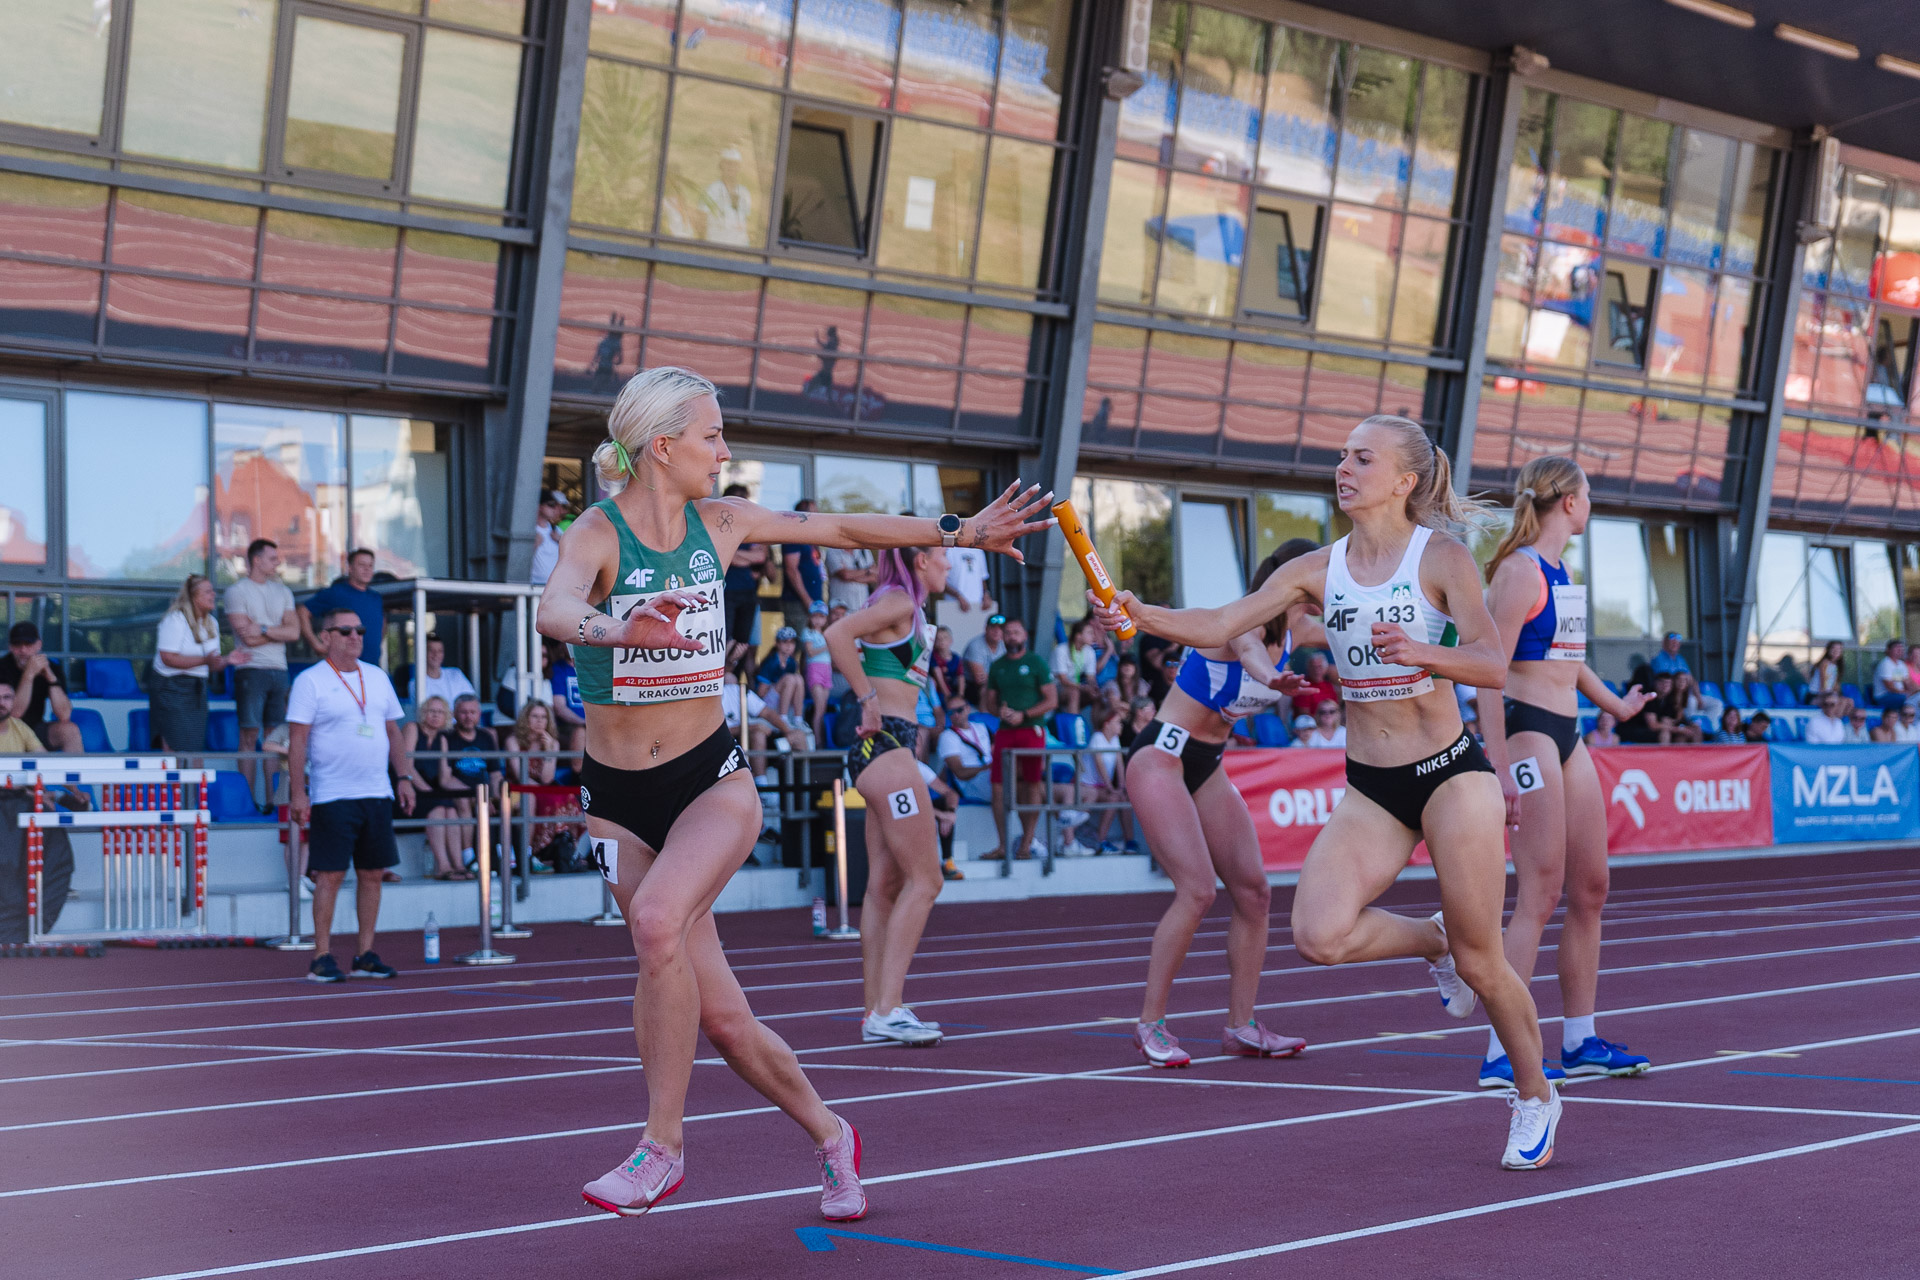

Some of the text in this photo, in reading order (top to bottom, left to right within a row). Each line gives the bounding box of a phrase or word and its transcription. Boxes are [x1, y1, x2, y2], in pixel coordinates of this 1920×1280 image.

[694, 554, 710, 567] AZS
[624, 568, 655, 588] 4F
[697, 569, 714, 582] AWF
[1326, 607, 1359, 632] 4F
[1375, 605, 1415, 623] 133
[656, 676, 698, 685] Mistrzostwa
[698, 672, 717, 680] Polski
[638, 683, 720, 699] KRAKÓW 2025
[1351, 687, 1414, 699] KRAKÓW 2025
[1163, 727, 1183, 750] 5
[718, 749, 740, 778] 4F
[1416, 735, 1470, 776] NIKE PRO
[1515, 763, 1535, 789] 6
[1793, 765, 1899, 808] MZLA
[896, 793, 911, 815] 8
[1674, 779, 1751, 814] ORLEN
[594, 841, 611, 879] 4
